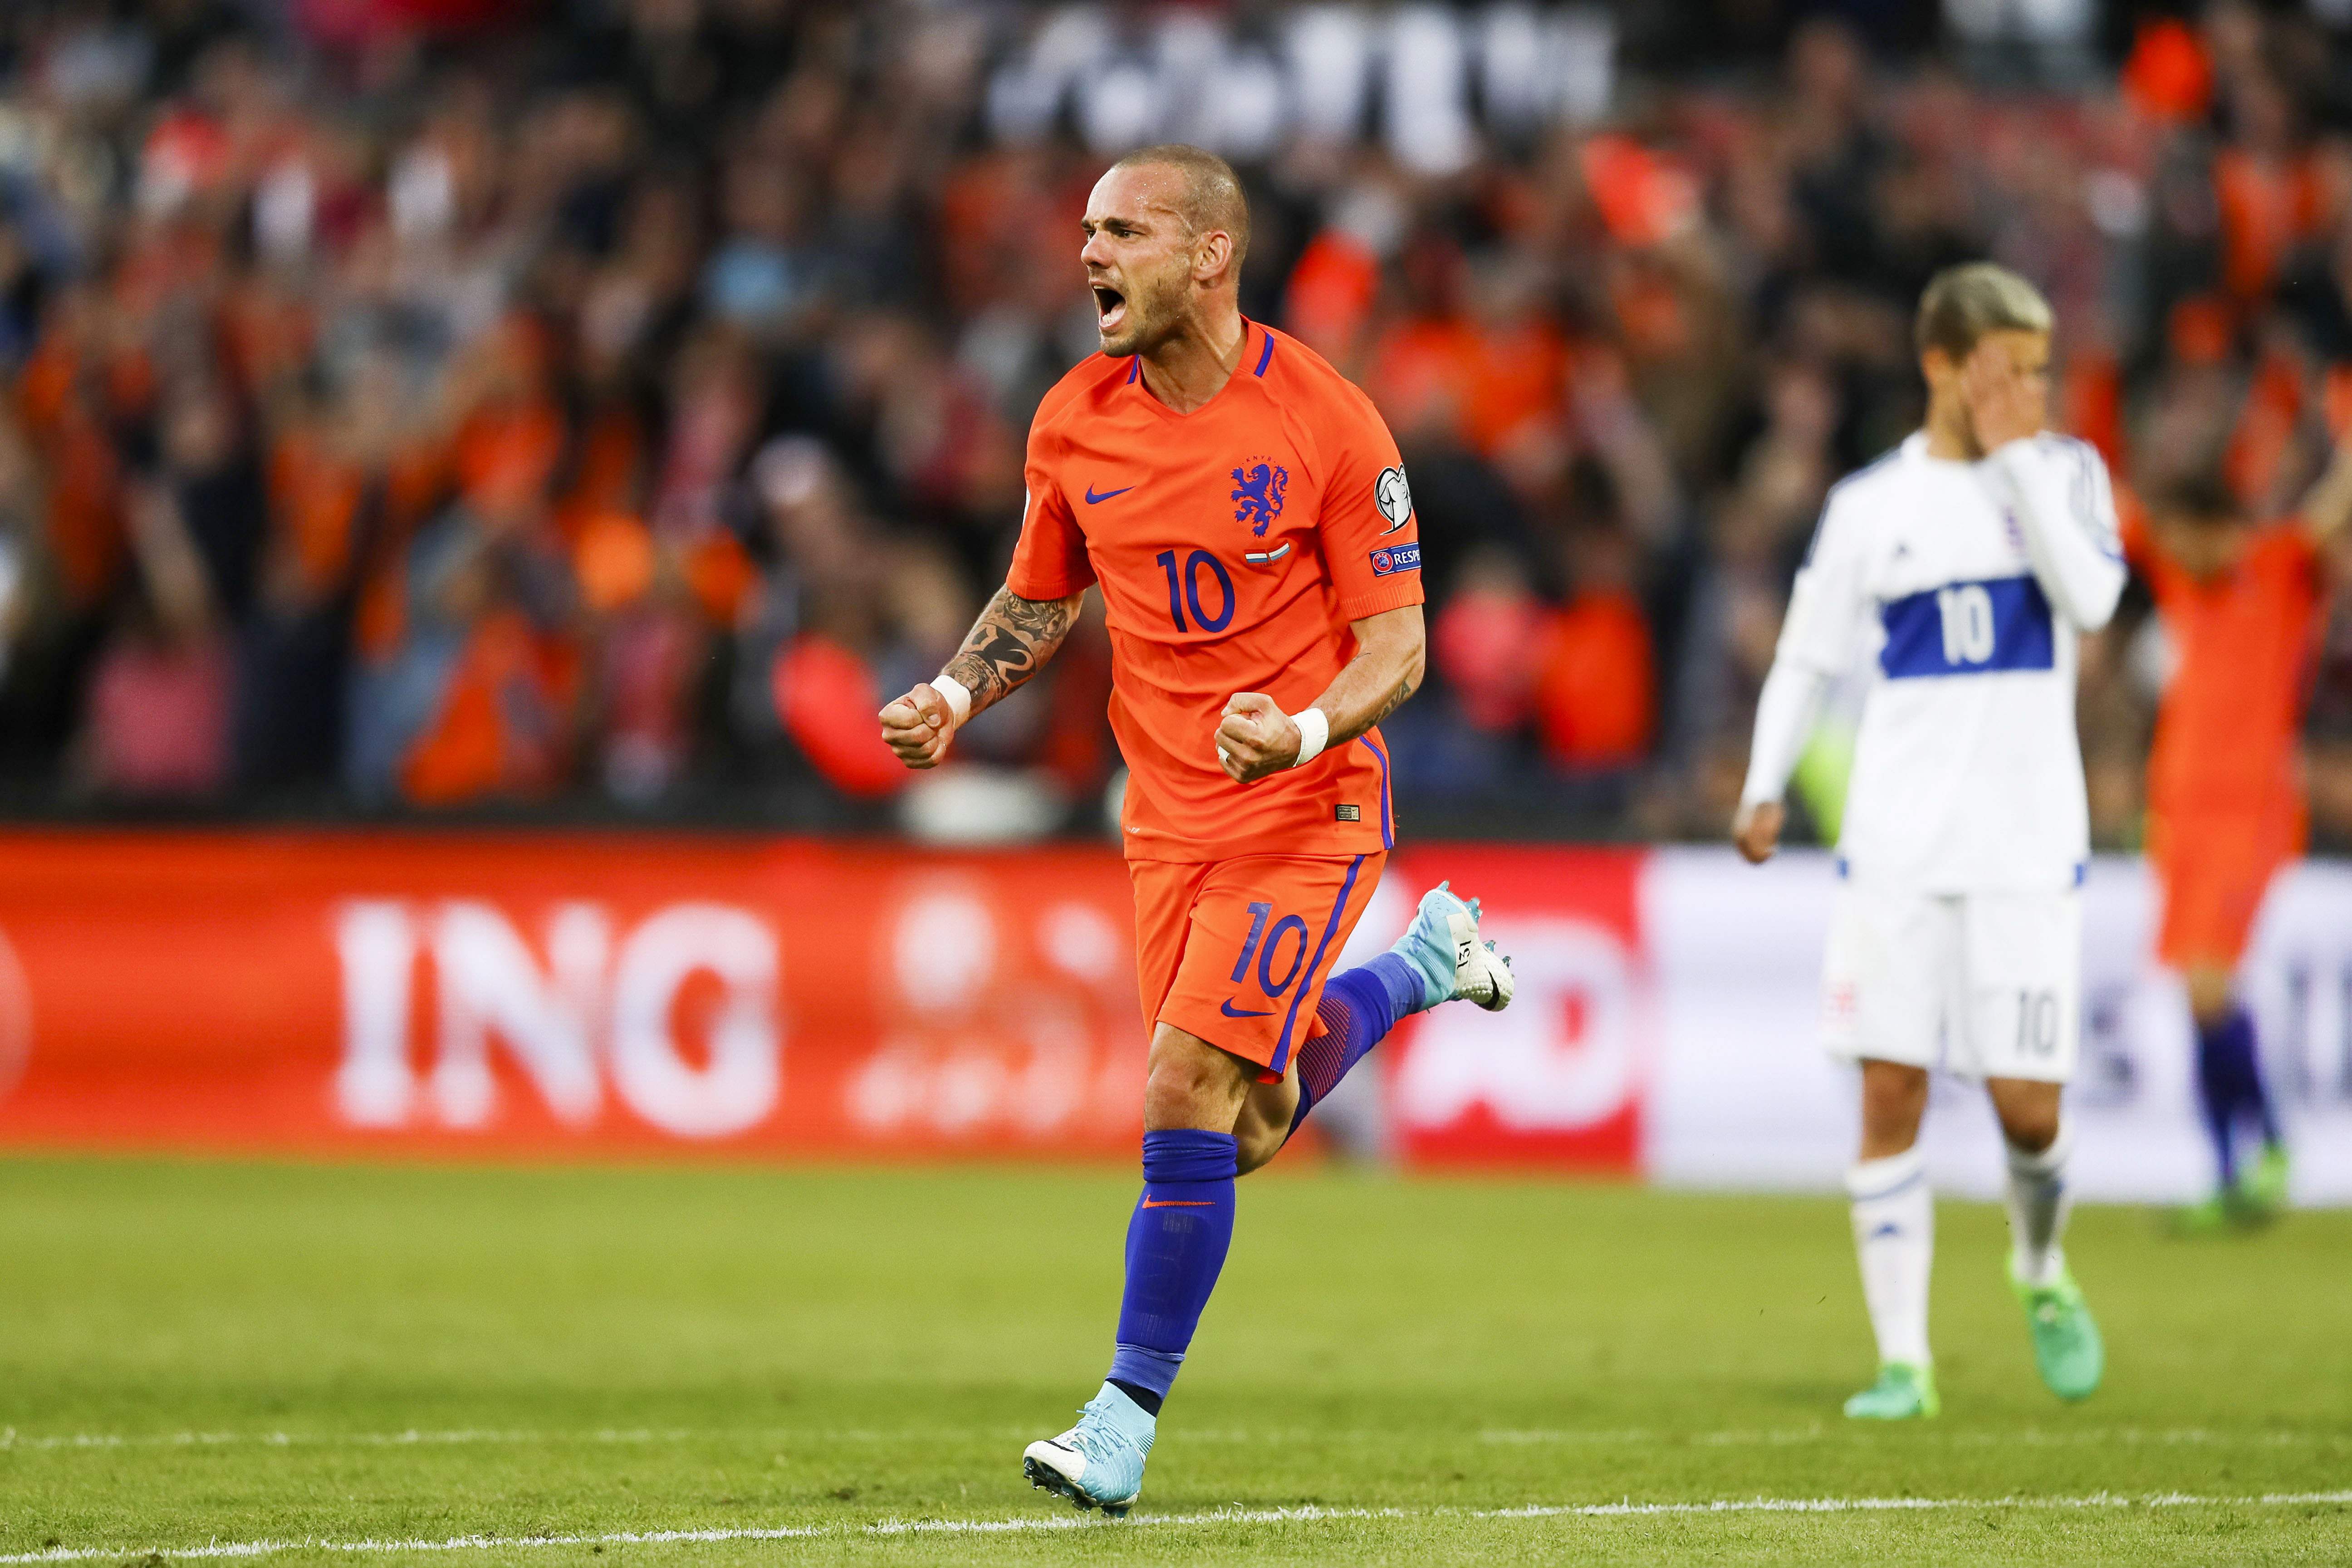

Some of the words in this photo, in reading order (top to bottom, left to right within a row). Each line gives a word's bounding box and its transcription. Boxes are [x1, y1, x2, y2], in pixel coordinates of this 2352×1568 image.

[1156, 549, 1235, 633] 10
[1937, 584, 1994, 666] 10
[1230, 902, 1308, 998] 10
[1456, 940, 1471, 970] 131
[335, 898, 781, 1138] ING
[2015, 986, 2060, 1058] 10
